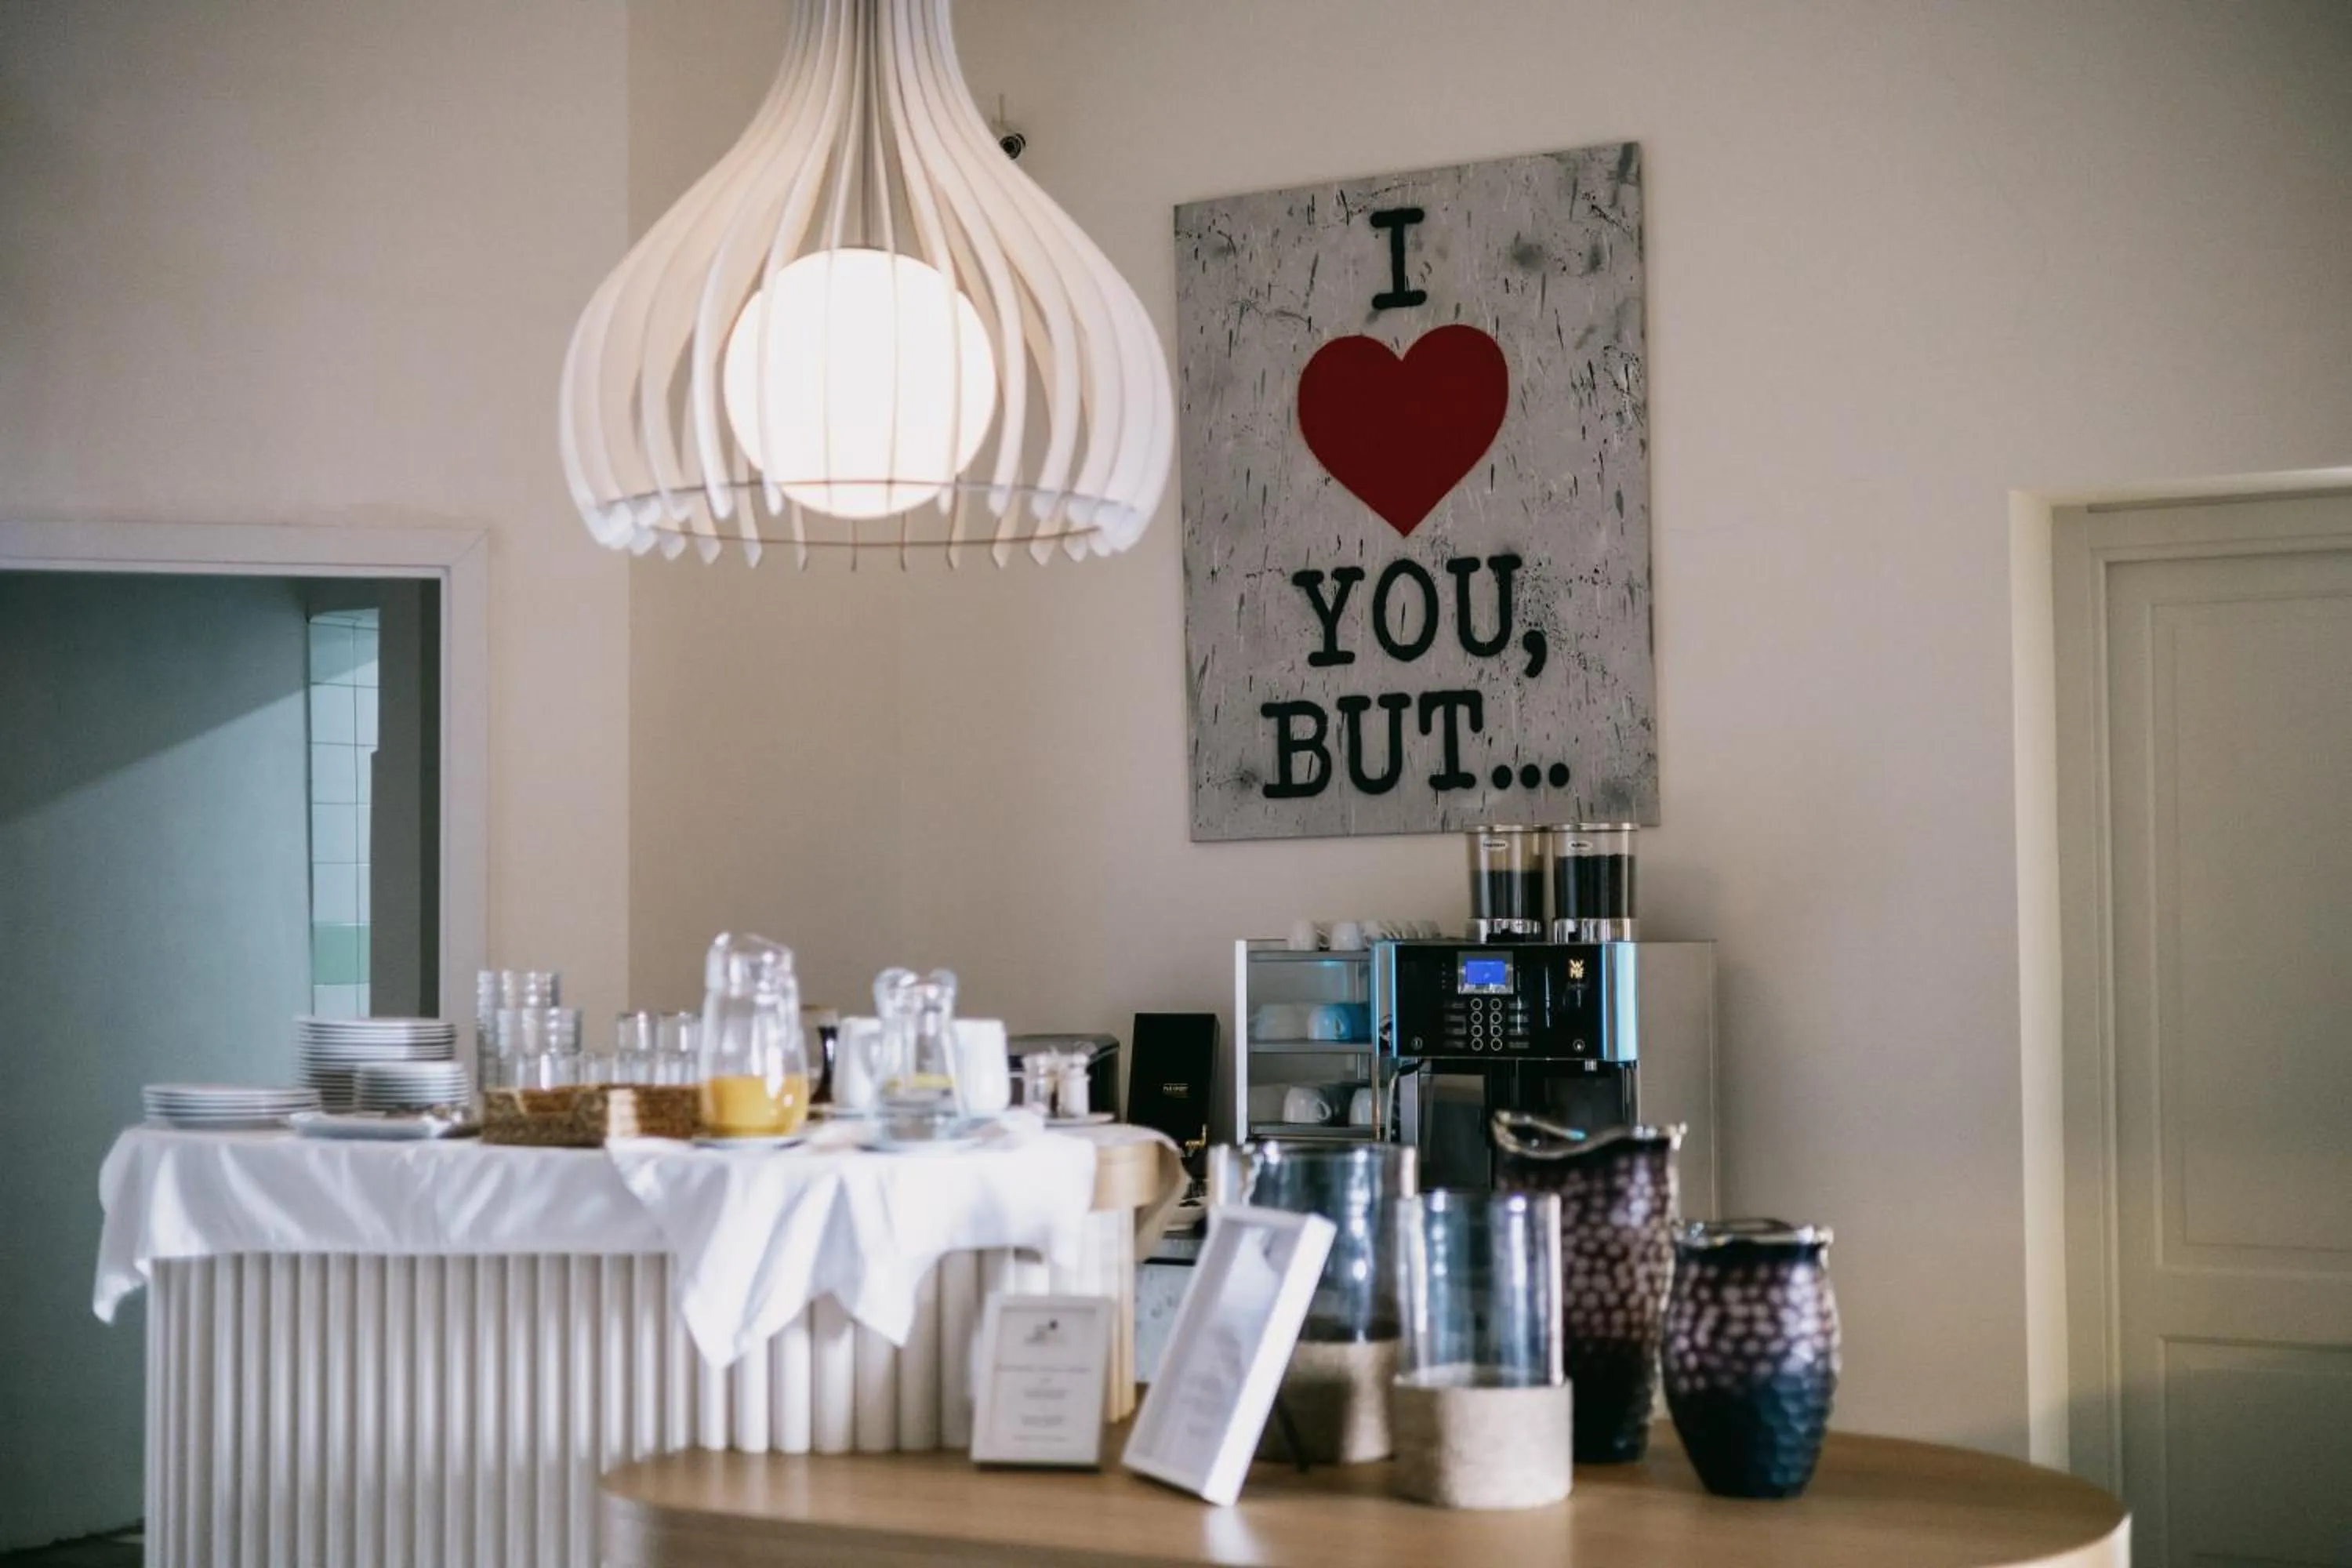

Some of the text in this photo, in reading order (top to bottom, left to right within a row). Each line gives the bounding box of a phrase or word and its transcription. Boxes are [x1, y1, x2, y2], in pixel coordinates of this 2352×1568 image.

[1370, 207, 1427, 310] I
[1292, 554, 1548, 677] YOU,
[1261, 690, 1570, 798] BUT...
